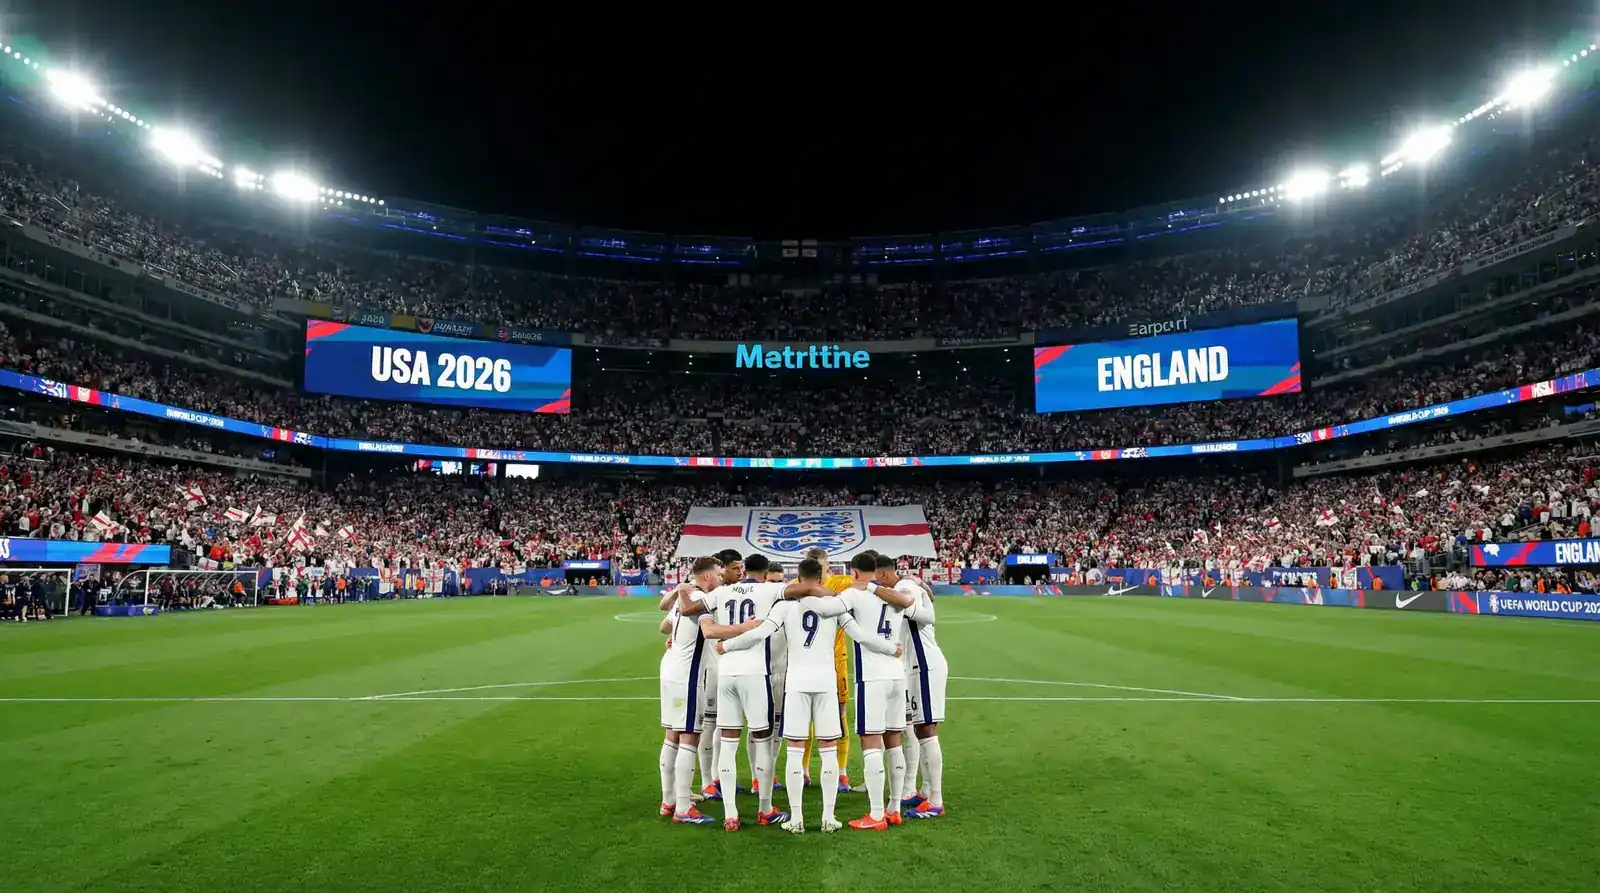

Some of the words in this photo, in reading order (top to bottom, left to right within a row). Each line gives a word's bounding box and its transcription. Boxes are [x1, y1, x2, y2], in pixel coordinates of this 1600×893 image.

[371, 345, 431, 385] USA
[437, 352, 512, 393] 2026
[1097, 345, 1229, 392] ENGLAND
[877, 603, 892, 640] 4
[1500, 599, 1524, 611] UEFA
[1524, 599, 1560, 612] WORLD
[1561, 600, 1583, 613] CUP
[802, 610, 820, 649] 9
